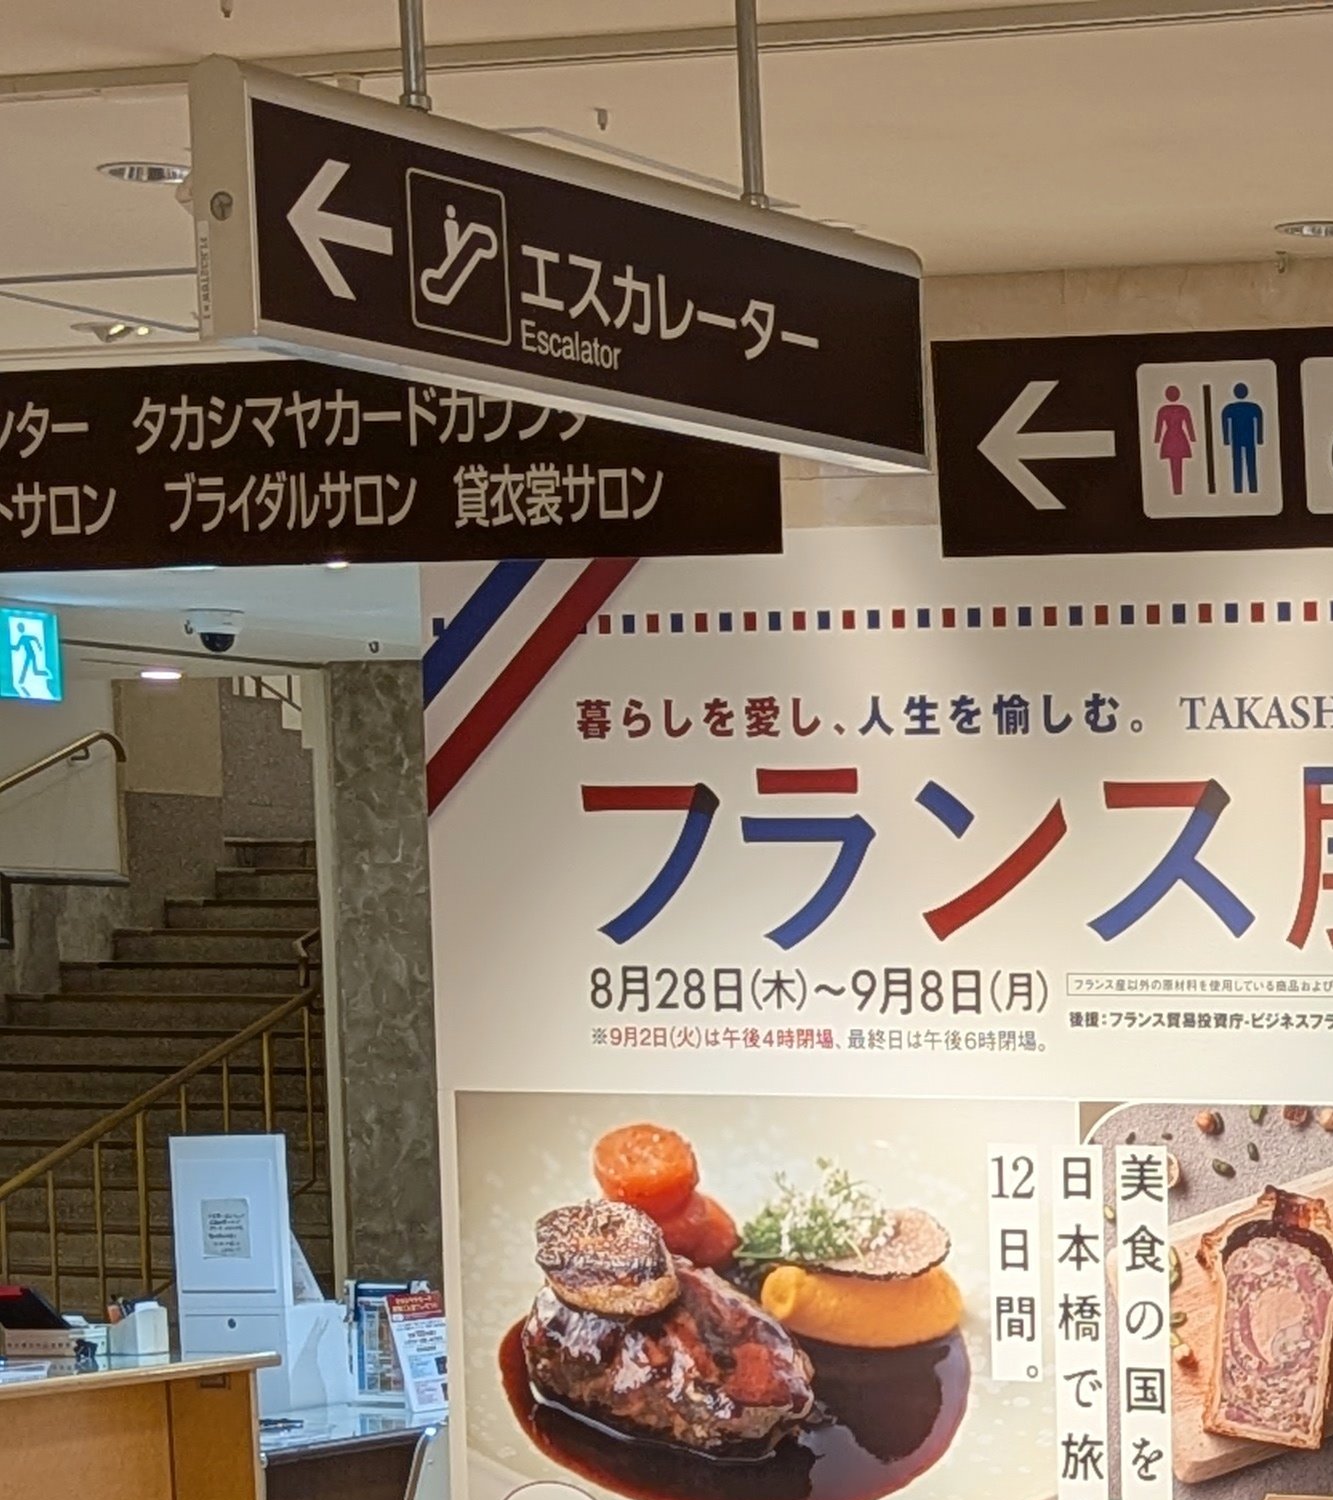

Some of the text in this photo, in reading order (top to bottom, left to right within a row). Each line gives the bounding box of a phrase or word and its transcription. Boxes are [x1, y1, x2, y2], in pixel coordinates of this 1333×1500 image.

[521, 244, 819, 361] エスカレーター
[521, 319, 622, 370] Escalator
[164, 470, 417, 532] ブライダルサロン
[453, 462, 663, 528] 貸衣裳サロン
[990, 1156, 1039, 1379] 12日間。
